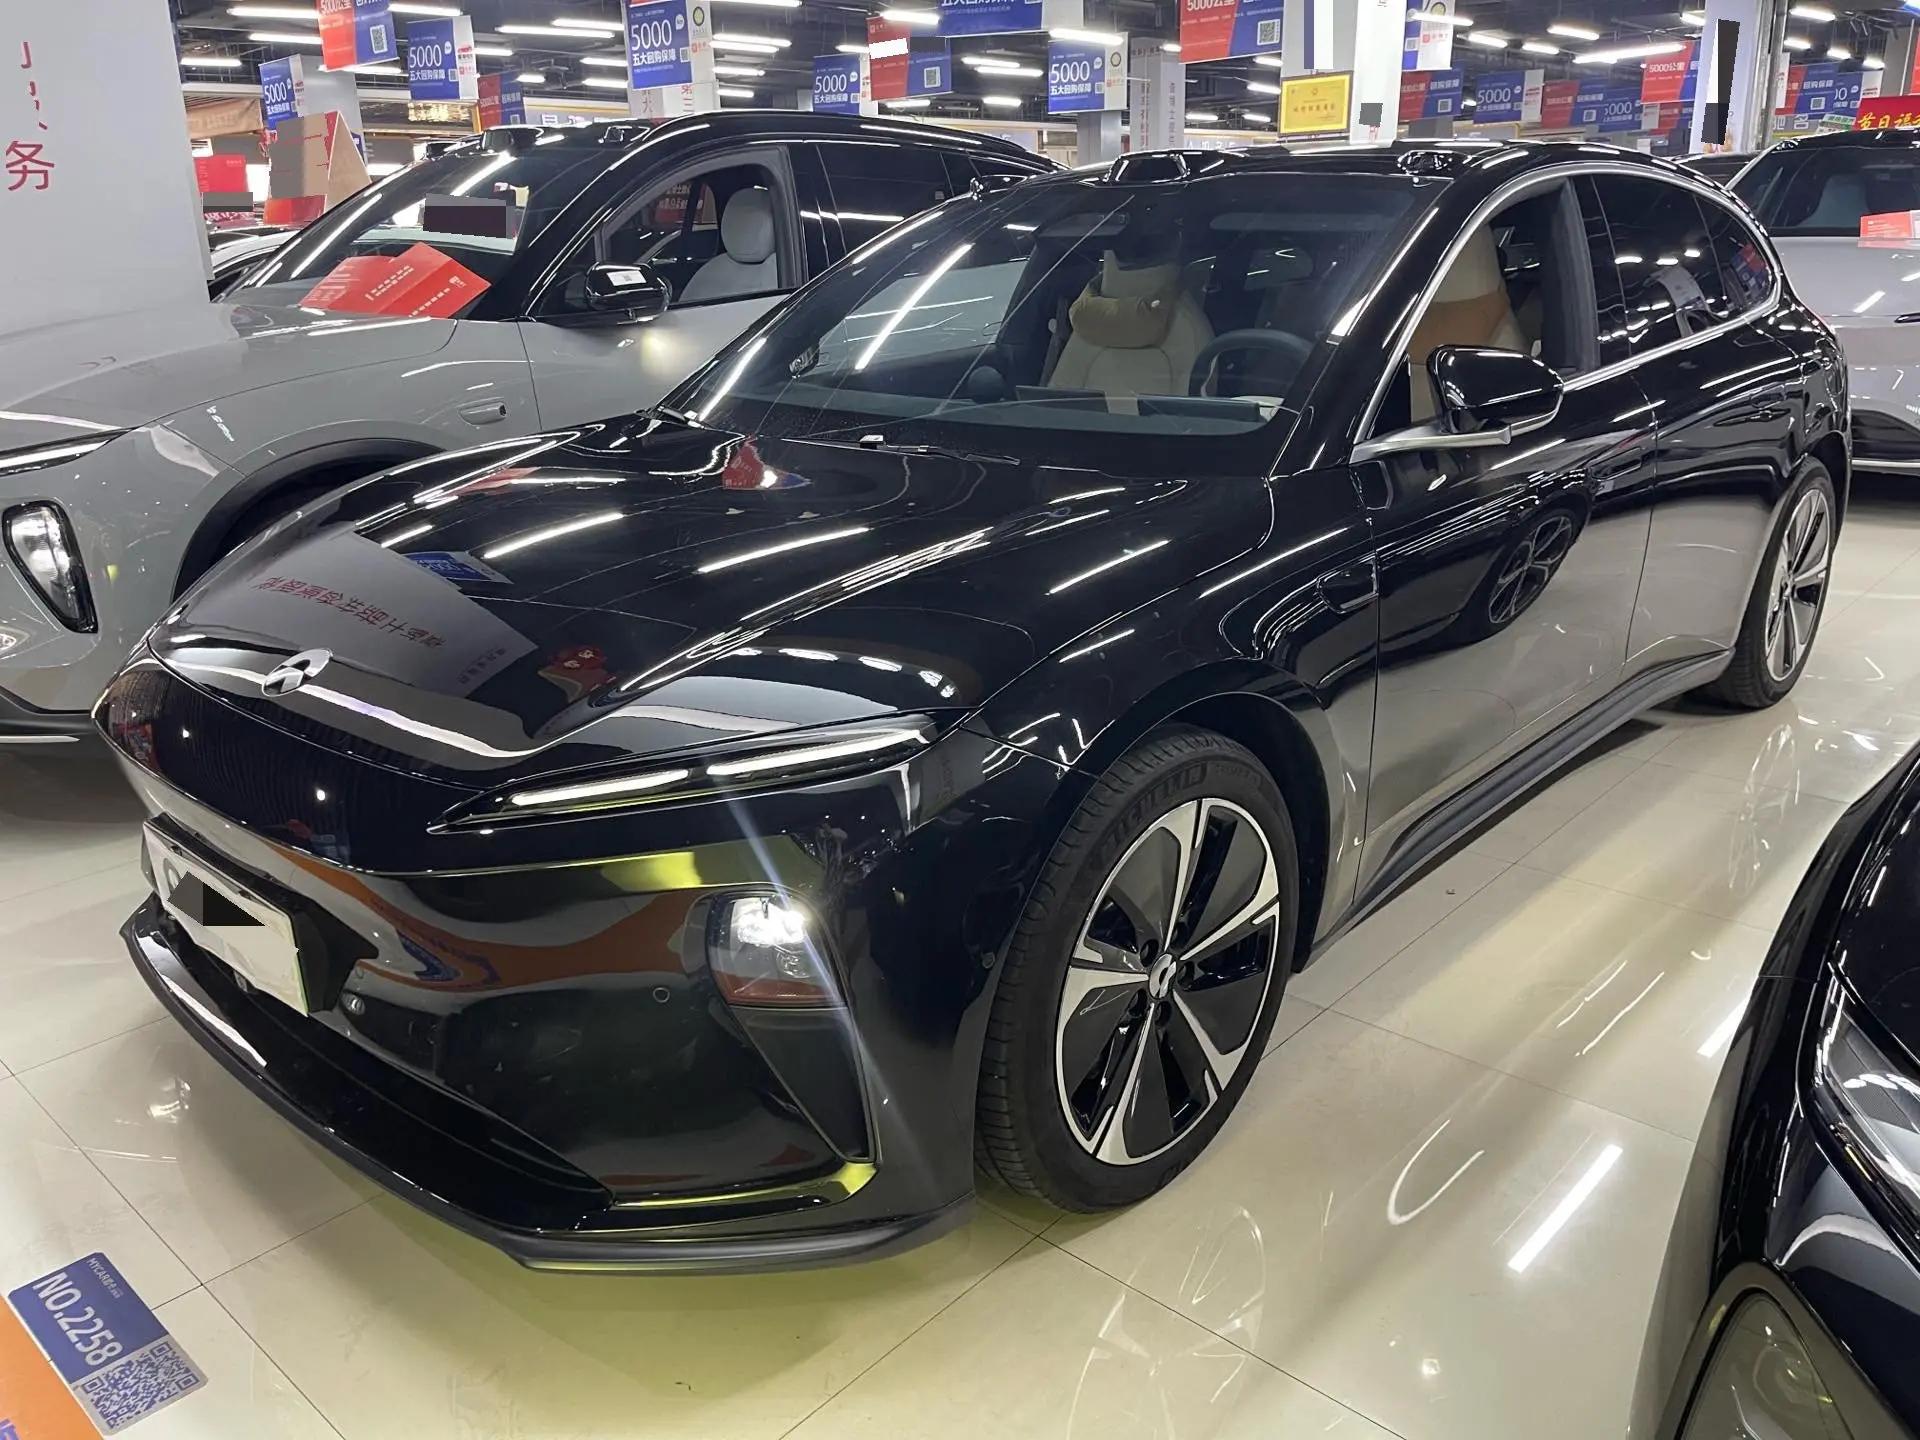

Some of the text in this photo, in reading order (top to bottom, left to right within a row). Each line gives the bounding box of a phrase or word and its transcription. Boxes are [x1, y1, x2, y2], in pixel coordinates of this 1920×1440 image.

[631, 19, 672, 51] 5000
[409, 44, 442, 68] 5000
[632, 48, 676, 66] 五大回购保障
[410, 69, 445, 81] 五大回购保障
[1050, 61, 1090, 83] 5000
[264, 82, 287, 105] 5000
[814, 74, 847, 93] 5000
[1050, 83, 1092, 96] 五大回购保障
[1478, 88, 1511, 104] 5000
[5, 140, 55, 191] 务
[32, 1271, 124, 1366] NO.2258
